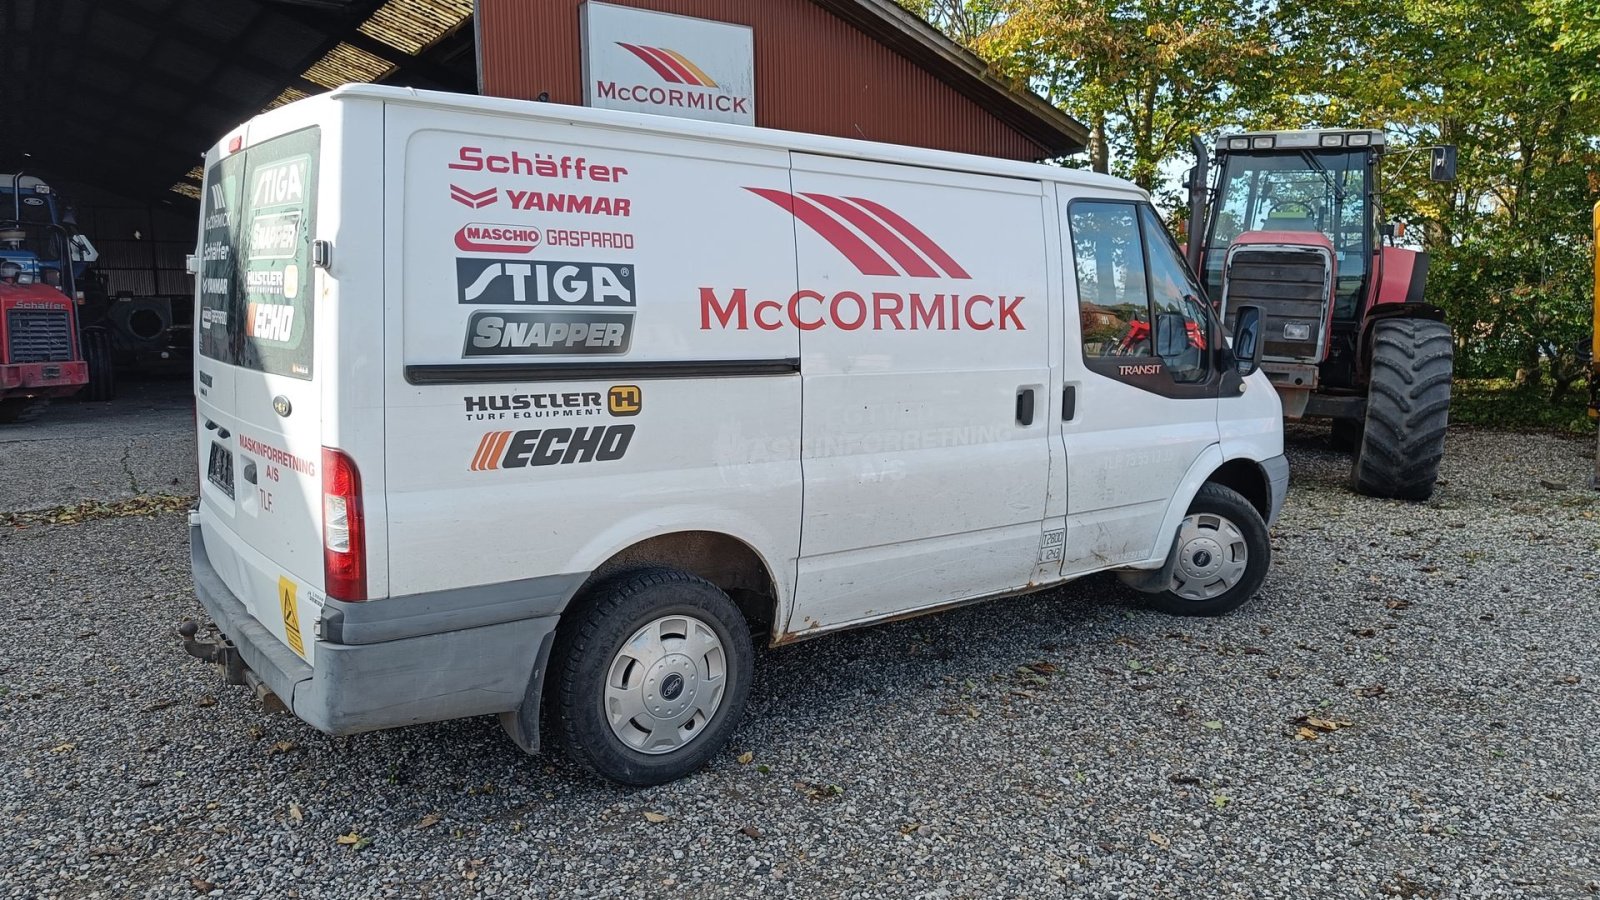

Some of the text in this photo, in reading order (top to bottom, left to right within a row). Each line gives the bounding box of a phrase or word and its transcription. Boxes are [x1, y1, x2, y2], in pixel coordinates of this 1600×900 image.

[448, 146, 628, 183] Schäffer
[505, 189, 631, 217] YANMAR
[467, 227, 634, 249] MASCHIO GASPARDO
[464, 262, 631, 303] STIGA
[254, 303, 295, 342] ECHO
[698, 287, 1026, 331] McCORMICK
[472, 316, 625, 348] SNAPPER
[1118, 364, 1162, 376] TRANSIT
[463, 392, 602, 412] HUSTLER
[465, 408, 602, 421] TURF EQUIPMENT
[239, 434, 315, 477] MASKINFORRETNING
[502, 424, 636, 469] ECHO
[266, 464, 280, 483] A/S
